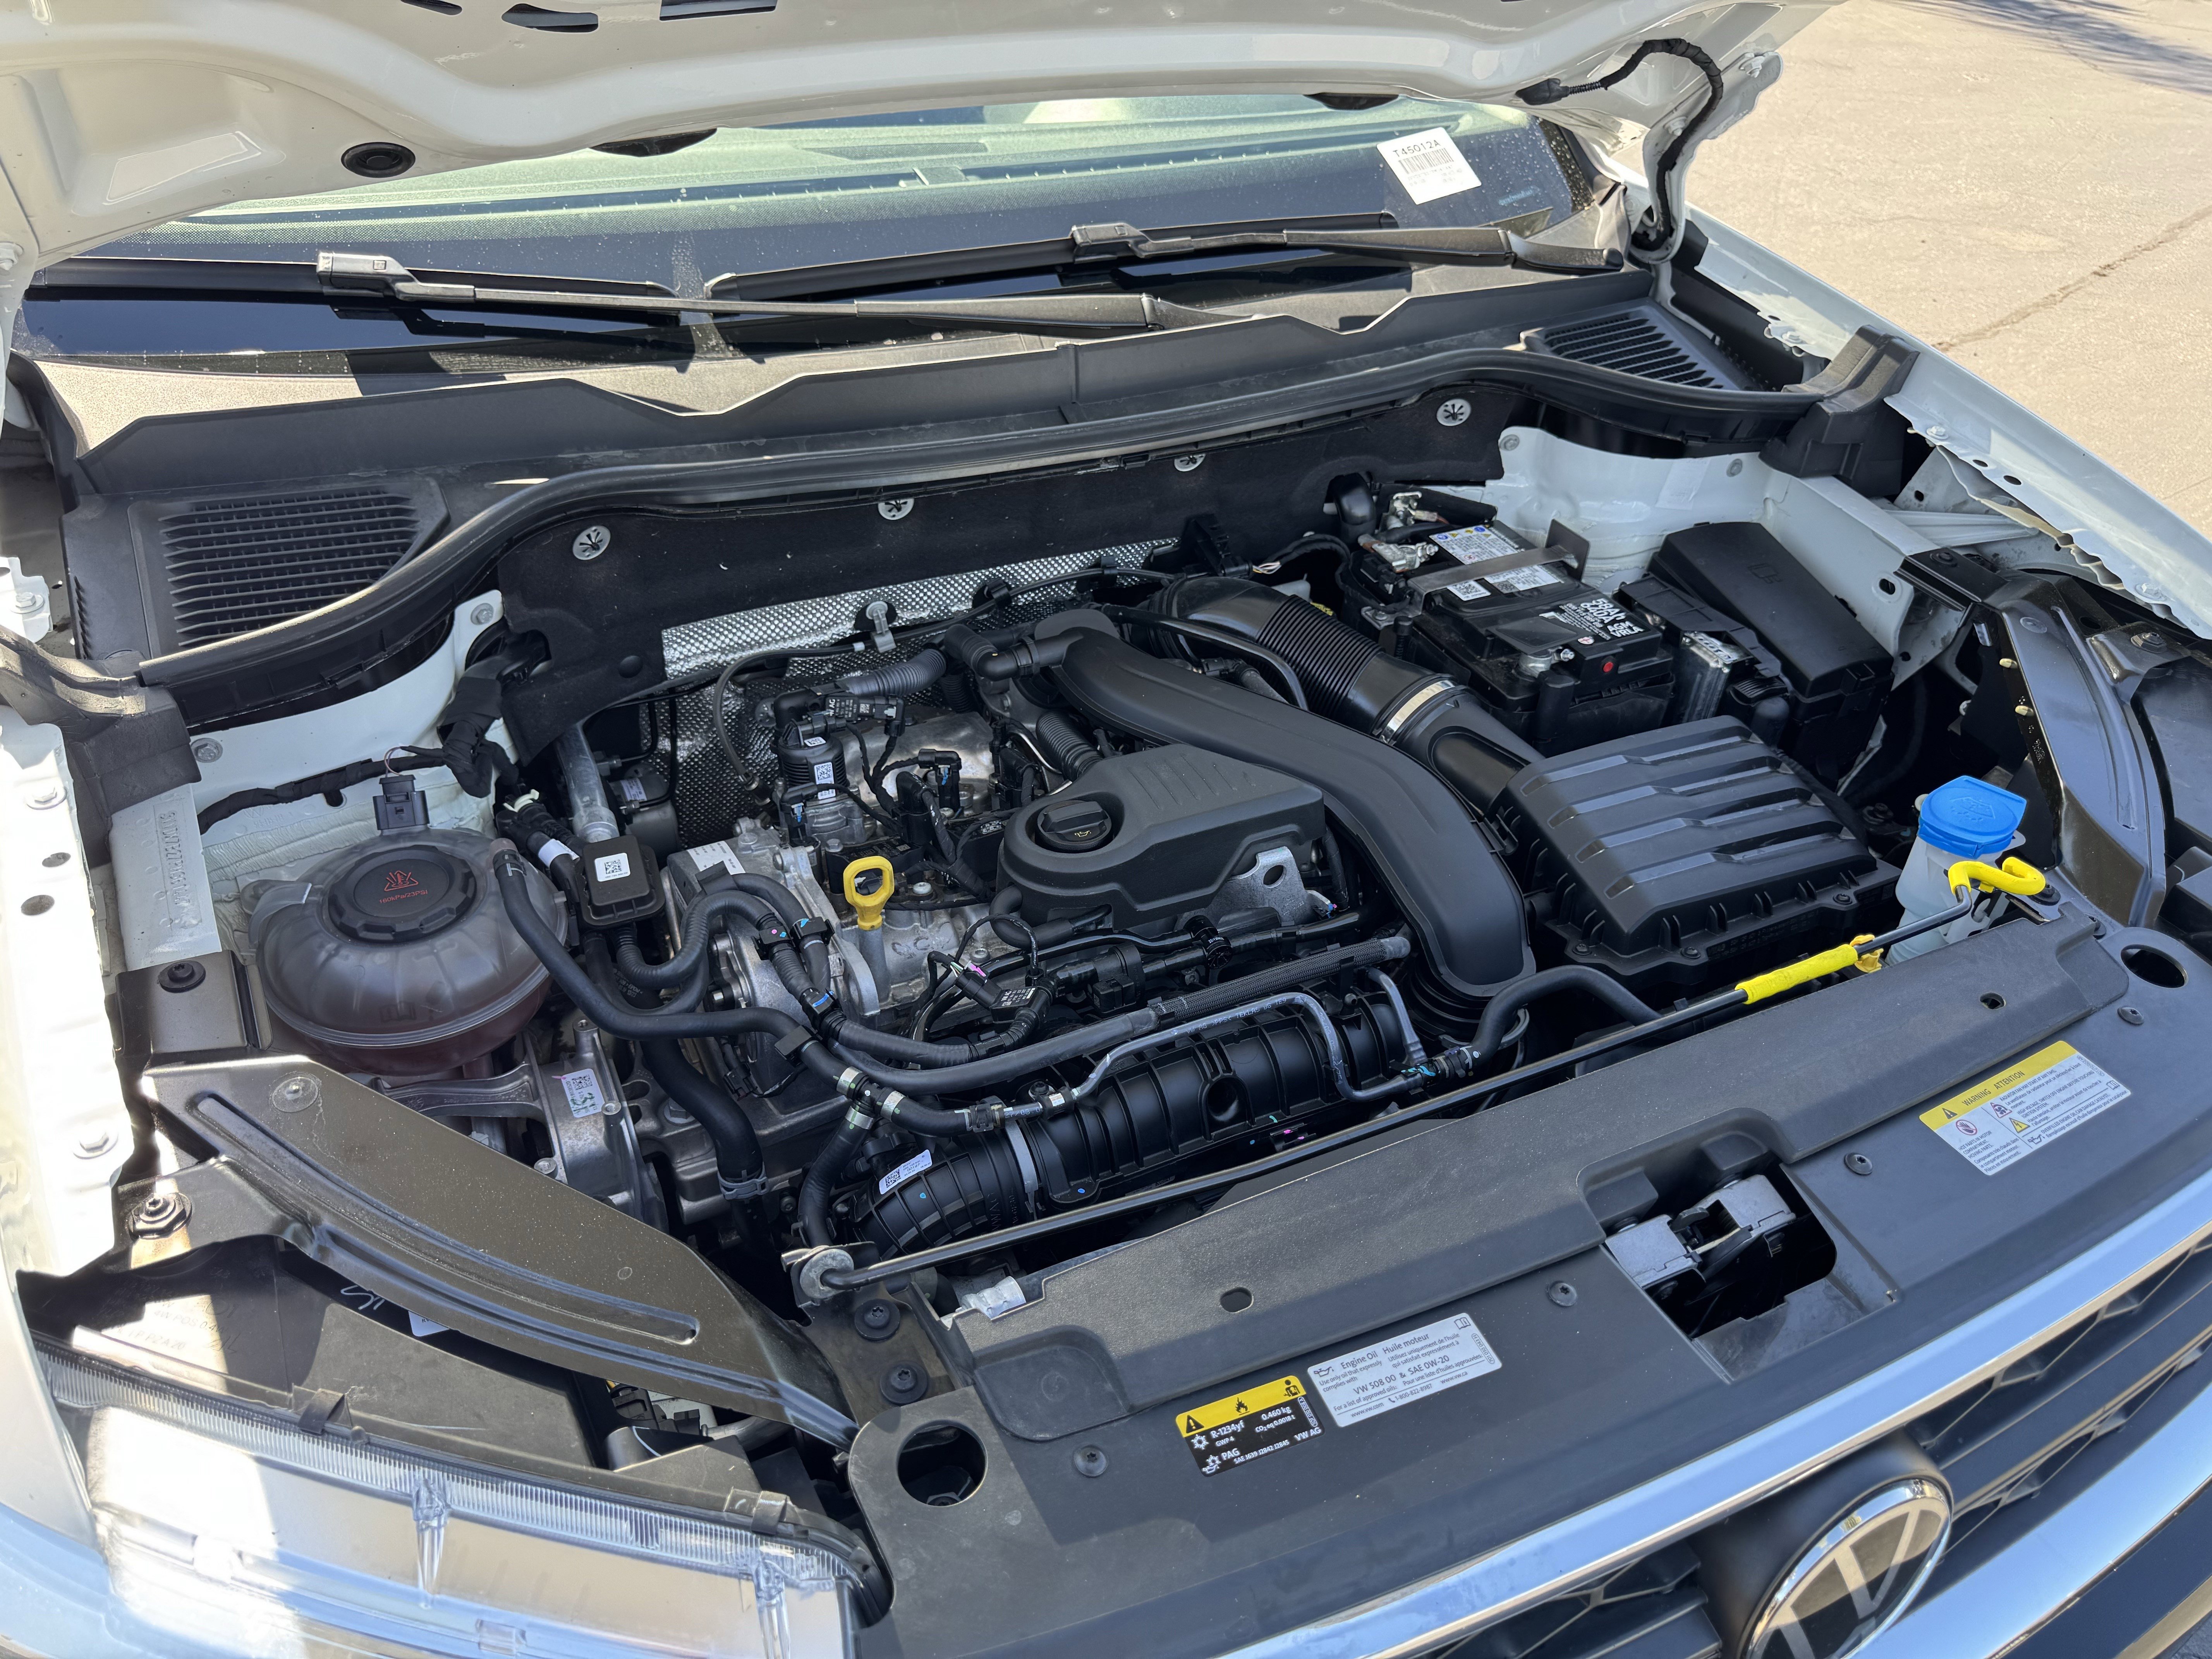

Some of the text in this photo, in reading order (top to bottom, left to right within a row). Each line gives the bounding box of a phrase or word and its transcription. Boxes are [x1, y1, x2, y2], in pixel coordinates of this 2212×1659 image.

[1393, 140, 1441, 157] T45012A
[1580, 602, 1614, 623] 640A
[1592, 598, 1626, 620] 58Ah
[1607, 621, 1635, 632] AGM
[1610, 626, 1645, 637] VRLA
[379, 890, 428, 903] 160kPa/23PSI
[1235, 1007, 1260, 1018] TEKLAS
[1962, 1071, 2025, 1106] WARNING ATTENTION
[2039, 1094, 2052, 1103] SWITCH
[2067, 1079, 2080, 1087] BEFORE
[2078, 1070, 2095, 1080] TOUCHING
[2021, 1109, 2037, 1118] IGNITION
[2041, 1121, 2060, 1133] OVERFILLED
[2059, 1115, 2072, 1123] ENGINE
[2081, 1101, 2096, 1110] DAMAGE
[1965, 1139, 1977, 1147] PARTS
[1979, 1131, 1992, 1139] MOTOR
[1968, 1149, 1983, 1159] MOVING
[1974, 1152, 1995, 1164] Composants
[1984, 1152, 2007, 1166] compartiment
[1341, 1334, 1429, 1369] Engine Oil Huile moteur
[1388, 1352, 1407, 1362] Utilisez
[1407, 1341, 1438, 1355] uniquement
[1444, 1333, 1460, 1341] l'huile
[1359, 1360, 1382, 1372] expressly
[1401, 1354, 1421, 1365] satisfait
[1436, 1364, 1455, 1374] d'huiles
[1454, 1354, 1483, 1367] approuvées:
[1353, 1384, 1368, 1394] VW
[1369, 1379, 1384, 1389] 508
[1385, 1375, 1396, 1383] 00
[1408, 1364, 1424, 1375] SAE
[1424, 1355, 1449, 1369] 0W-20
[1440, 1371, 1468, 1384] www.vw.ca
[1323, 1381, 1346, 1392] complies
[1395, 1383, 1432, 1400] 1-800-822-8987
[1362, 1388, 1386, 1401] approved
[1261, 1409, 1281, 1420] 0.460
[1351, 1403, 1384, 1417] www.vw.com
[1274, 1416, 1291, 1425] 0.0018
[1211, 1420, 1244, 1438] R-1234yf
[1294, 1427, 1321, 1441] VW AG
[1216, 1438, 1229, 1446] GWP
[1221, 1448, 1240, 1460] PAG
[1234, 1440, 1290, 1464] SAE J639 J2842 J2845
